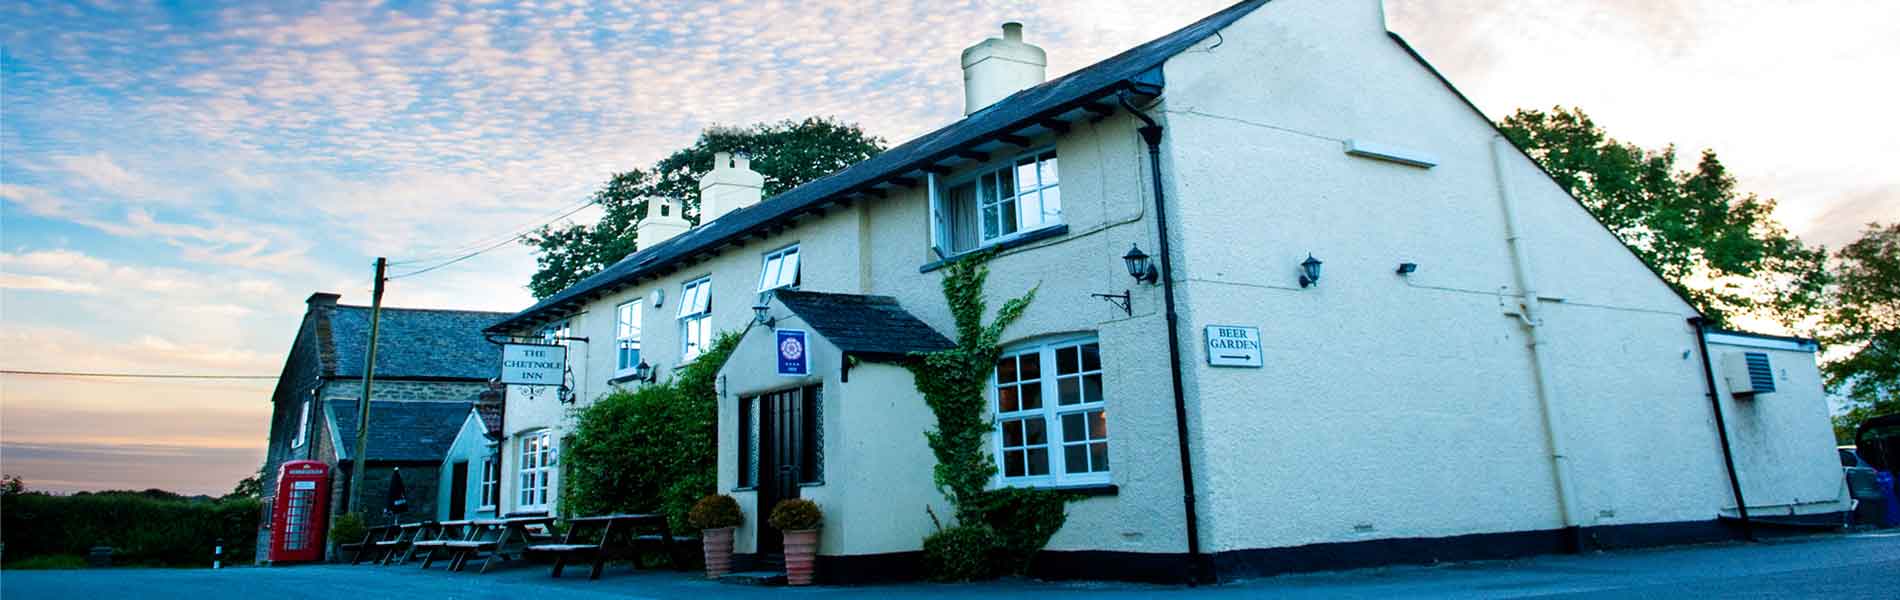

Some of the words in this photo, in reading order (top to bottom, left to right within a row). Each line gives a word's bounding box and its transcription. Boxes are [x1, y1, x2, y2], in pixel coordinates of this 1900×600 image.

[1218, 327, 1248, 339] BEER
[1210, 338, 1258, 350] GARDEN
[522, 349, 545, 358] THE
[503, 359, 562, 370] CHETNOLE
[521, 371, 544, 380] INN
